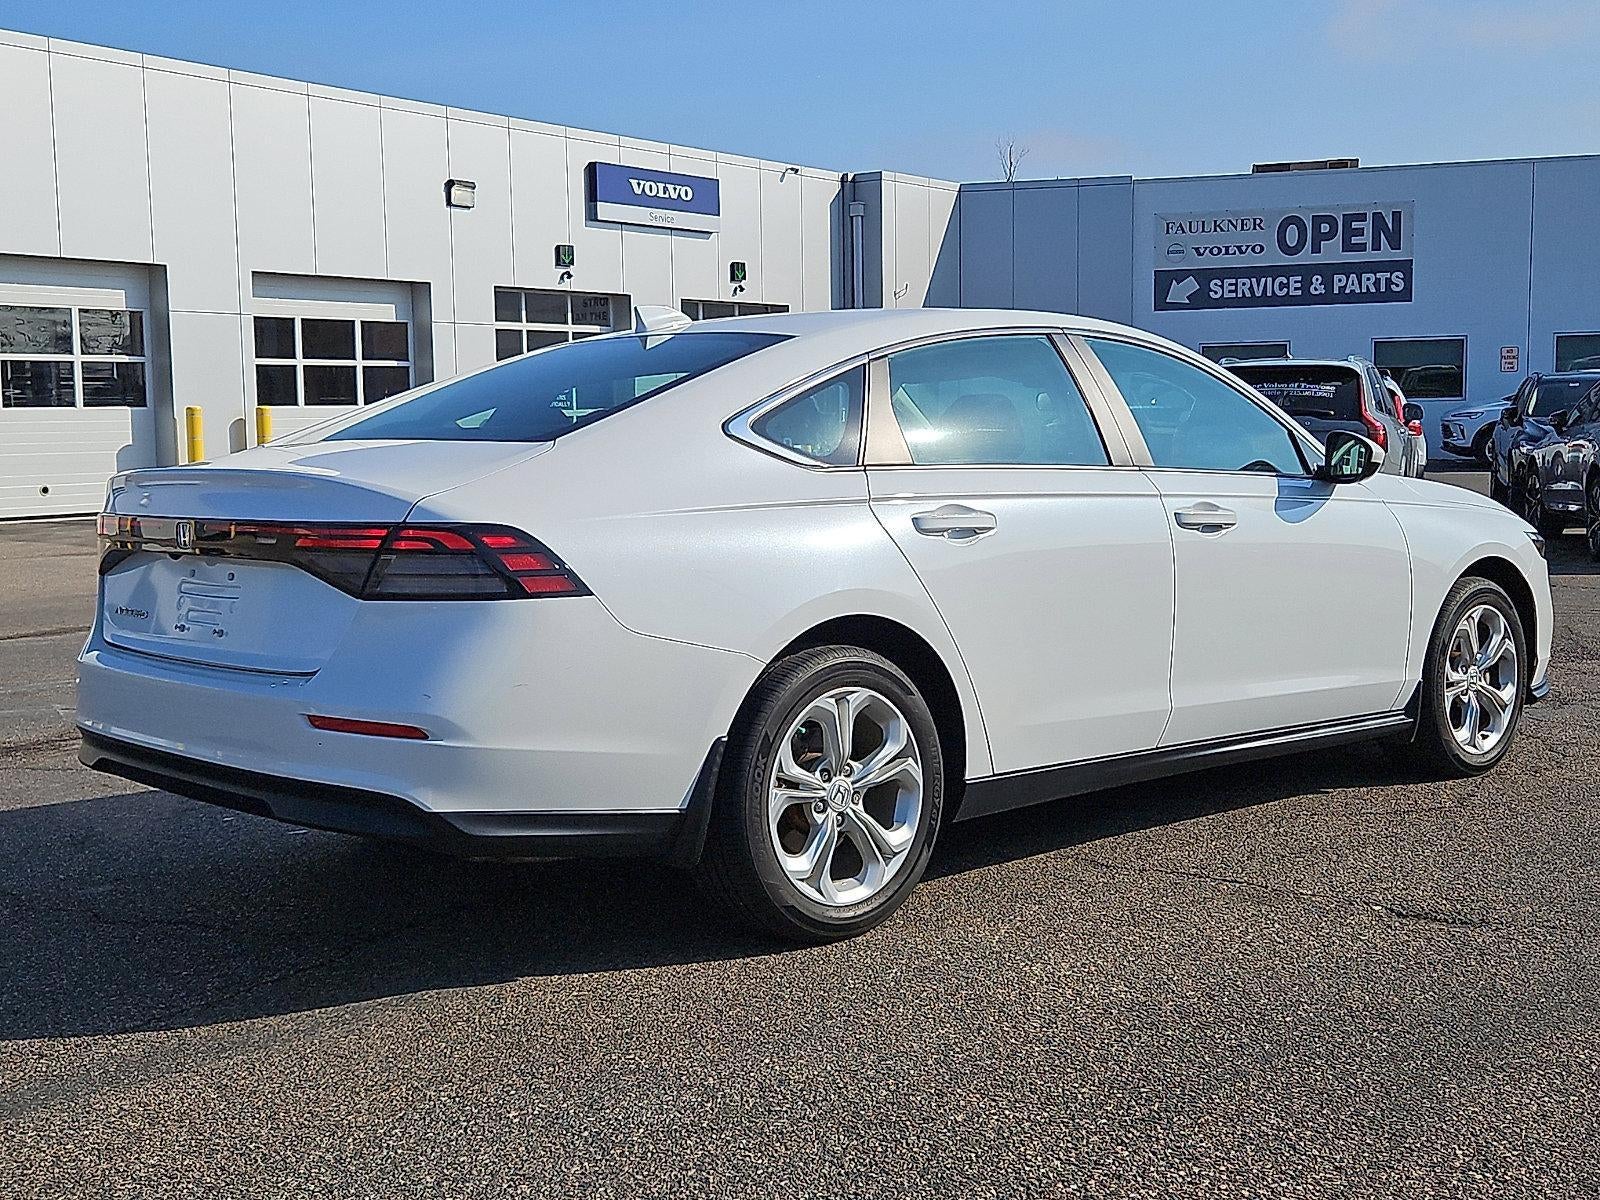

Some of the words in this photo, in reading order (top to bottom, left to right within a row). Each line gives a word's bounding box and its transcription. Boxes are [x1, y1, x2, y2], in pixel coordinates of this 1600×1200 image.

[628, 178, 694, 202] VOLVO
[648, 211, 676, 225] Service
[1165, 217, 1266, 236] FAULKNER
[1275, 209, 1404, 258] OPEN
[1191, 243, 1266, 257] VOLVO
[1208, 275, 1303, 299] SERVICE
[1309, 275, 1326, 295] &
[1333, 271, 1406, 294] PARTS
